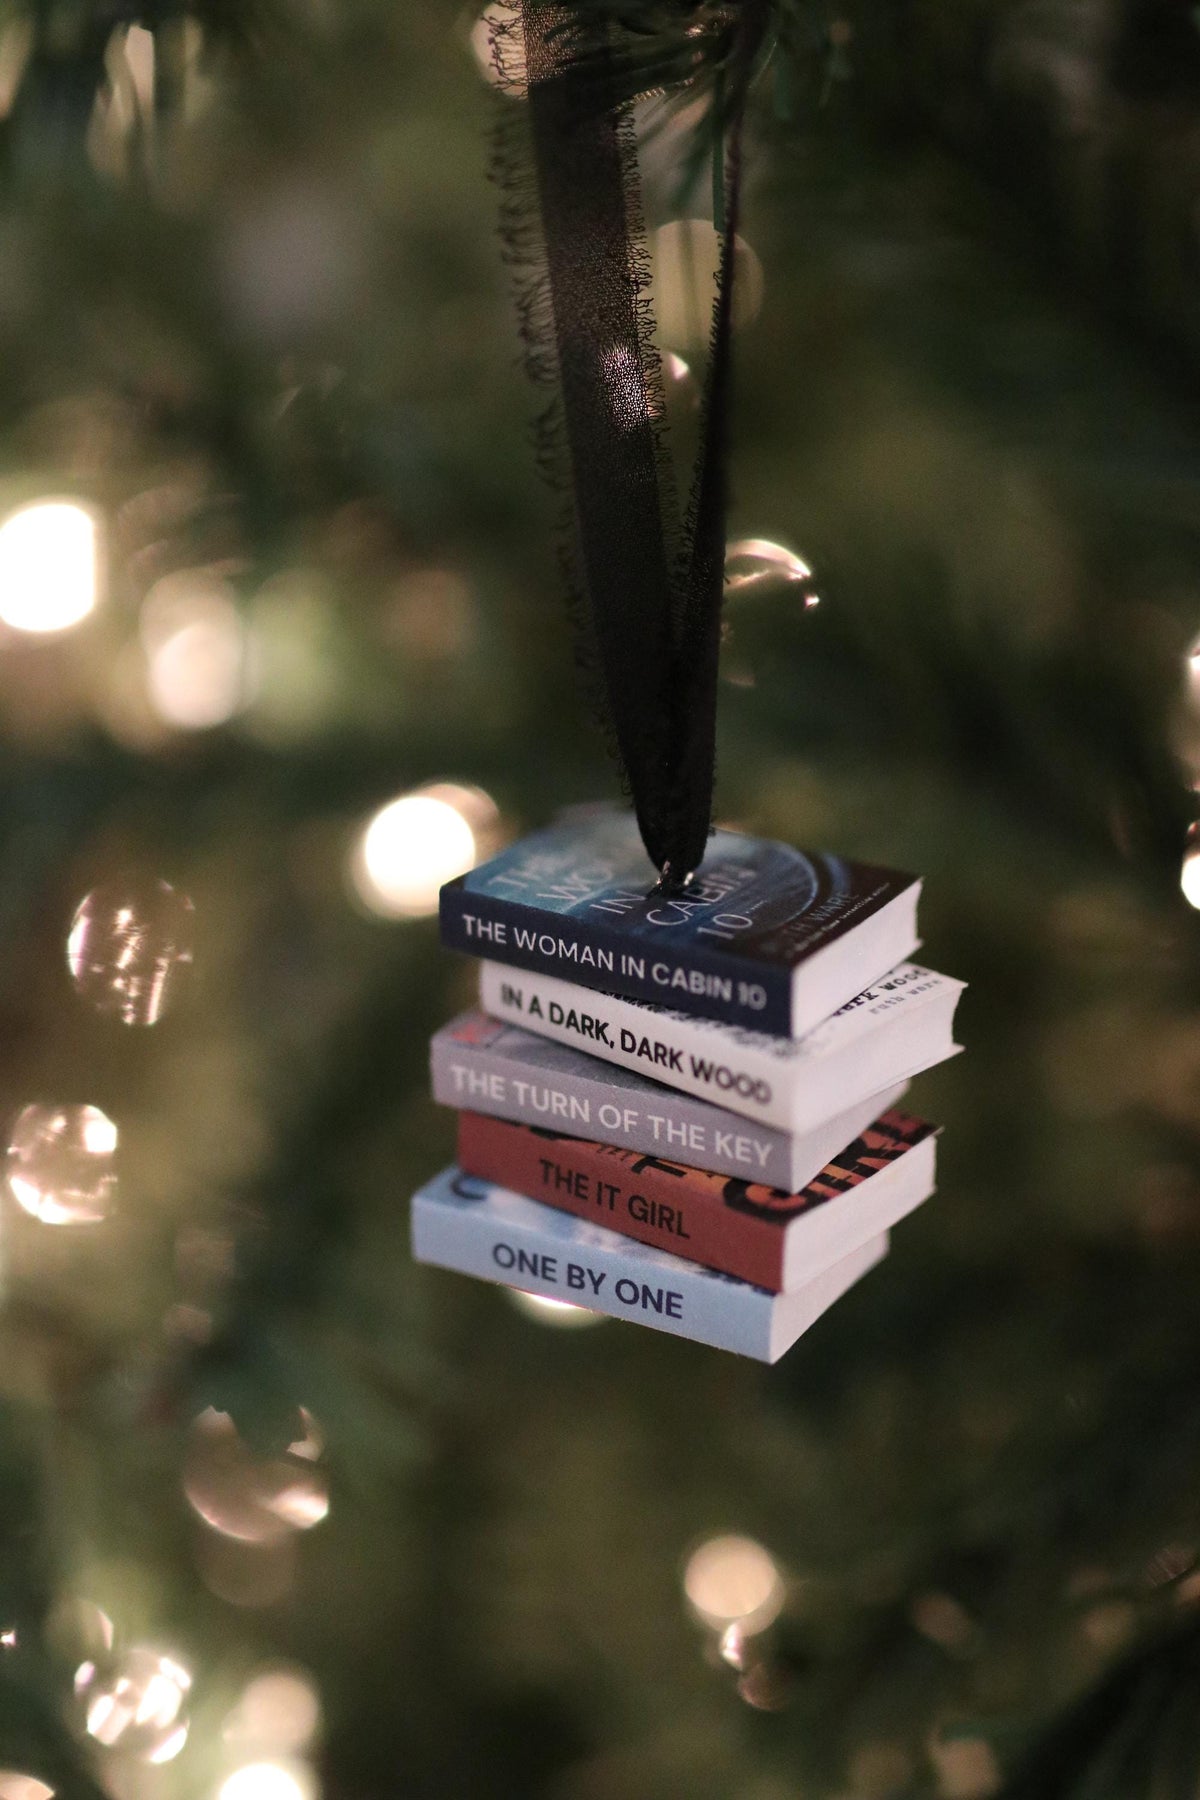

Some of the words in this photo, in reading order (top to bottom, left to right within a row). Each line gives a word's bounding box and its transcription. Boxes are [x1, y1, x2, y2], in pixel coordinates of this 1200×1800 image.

[589, 888, 648, 915] IN
[462, 913, 507, 945] THE
[513, 927, 614, 972] WOMAN
[621, 954, 646, 980] IN
[651, 962, 733, 1003] CABIN
[737, 979, 768, 1011] 10
[501, 983, 522, 1010] IN
[528, 995, 543, 1019] A
[549, 1002, 615, 1049] DARK,
[620, 1028, 683, 1073] DARK
[689, 1054, 772, 1105] WOOD
[451, 1065, 506, 1102] THE
[512, 1080, 590, 1123] TURN
[598, 1104, 639, 1133] OF
[647, 1115, 705, 1151] THE
[714, 1130, 773, 1167] KEY
[539, 1158, 590, 1200] THE
[597, 1181, 621, 1212] IT
[627, 1195, 691, 1239] GIRL
[493, 1243, 558, 1284] ONE
[566, 1263, 606, 1296] BY
[615, 1278, 684, 1320] ONE
